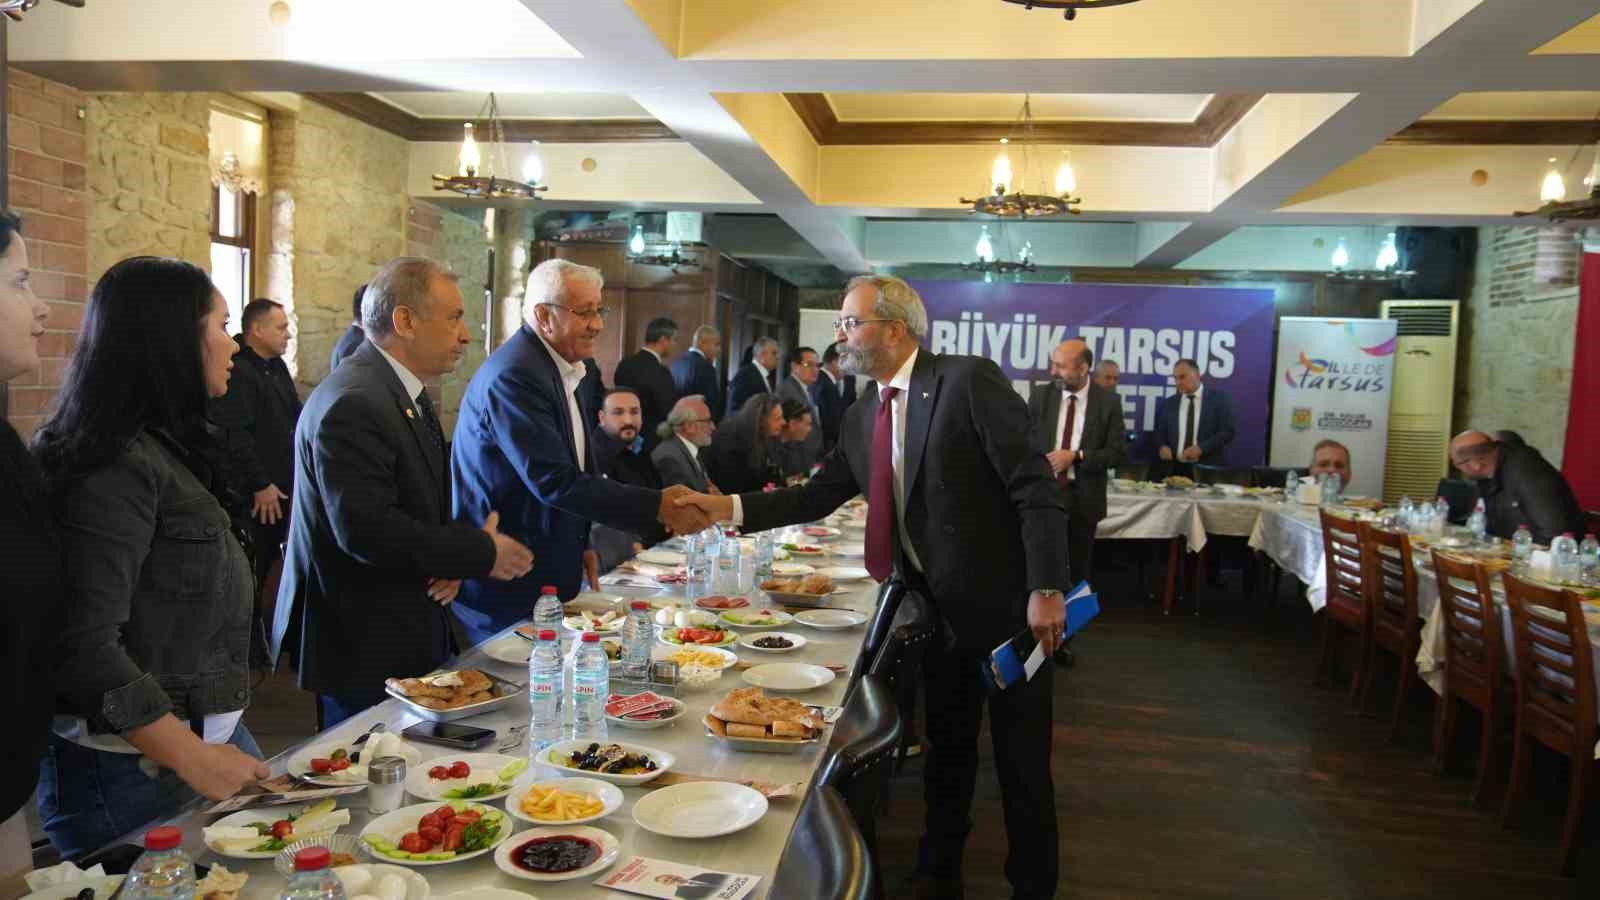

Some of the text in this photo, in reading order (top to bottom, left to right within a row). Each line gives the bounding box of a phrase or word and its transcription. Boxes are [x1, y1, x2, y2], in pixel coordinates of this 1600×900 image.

[932, 311, 1236, 379] BÜYÜK TARSUS
[1295, 367, 1385, 392] tarsus
